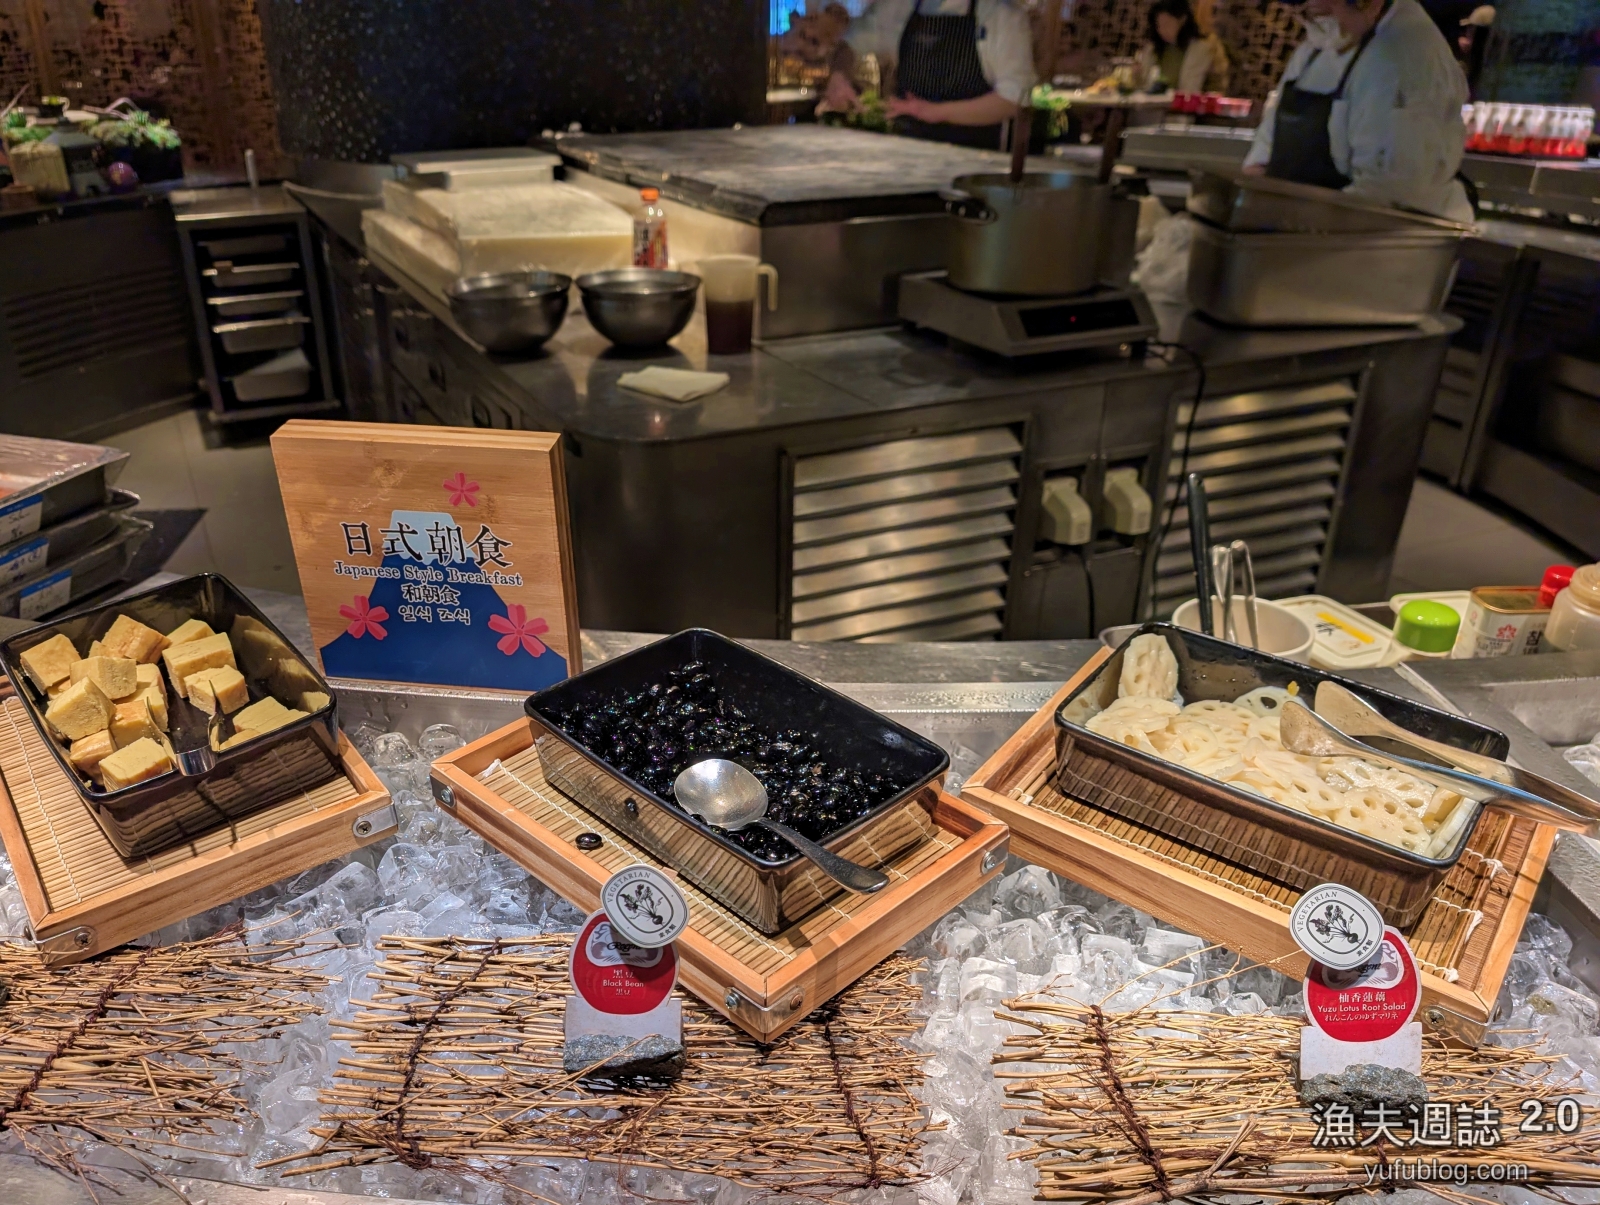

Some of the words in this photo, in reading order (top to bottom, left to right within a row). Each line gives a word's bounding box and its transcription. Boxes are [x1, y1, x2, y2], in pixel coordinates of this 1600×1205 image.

[341, 522, 513, 567] 日式朝食
[334, 561, 400, 579] Japanese
[404, 565, 443, 583] Style
[449, 568, 522, 586] Breakfast
[402, 584, 460, 605] 和朝食
[399, 605, 432, 622] 일식
[438, 608, 470, 624] 조식
[607, 872, 651, 903] VEGETARIAN
[1297, 891, 1337, 932] VEGETARIAN
[602, 979, 623, 987] Black
[625, 980, 644, 988] Bean
[1339, 991, 1386, 1003] 柚香蓮藕
[1317, 1005, 1337, 1013] Yuzu
[1340, 1003, 1360, 1012] Lotus
[1362, 1003, 1380, 1011] Root
[1382, 1002, 1406, 1011] Salad
[1324, 1011, 1399, 1022] れんこんのゆずマリネ
